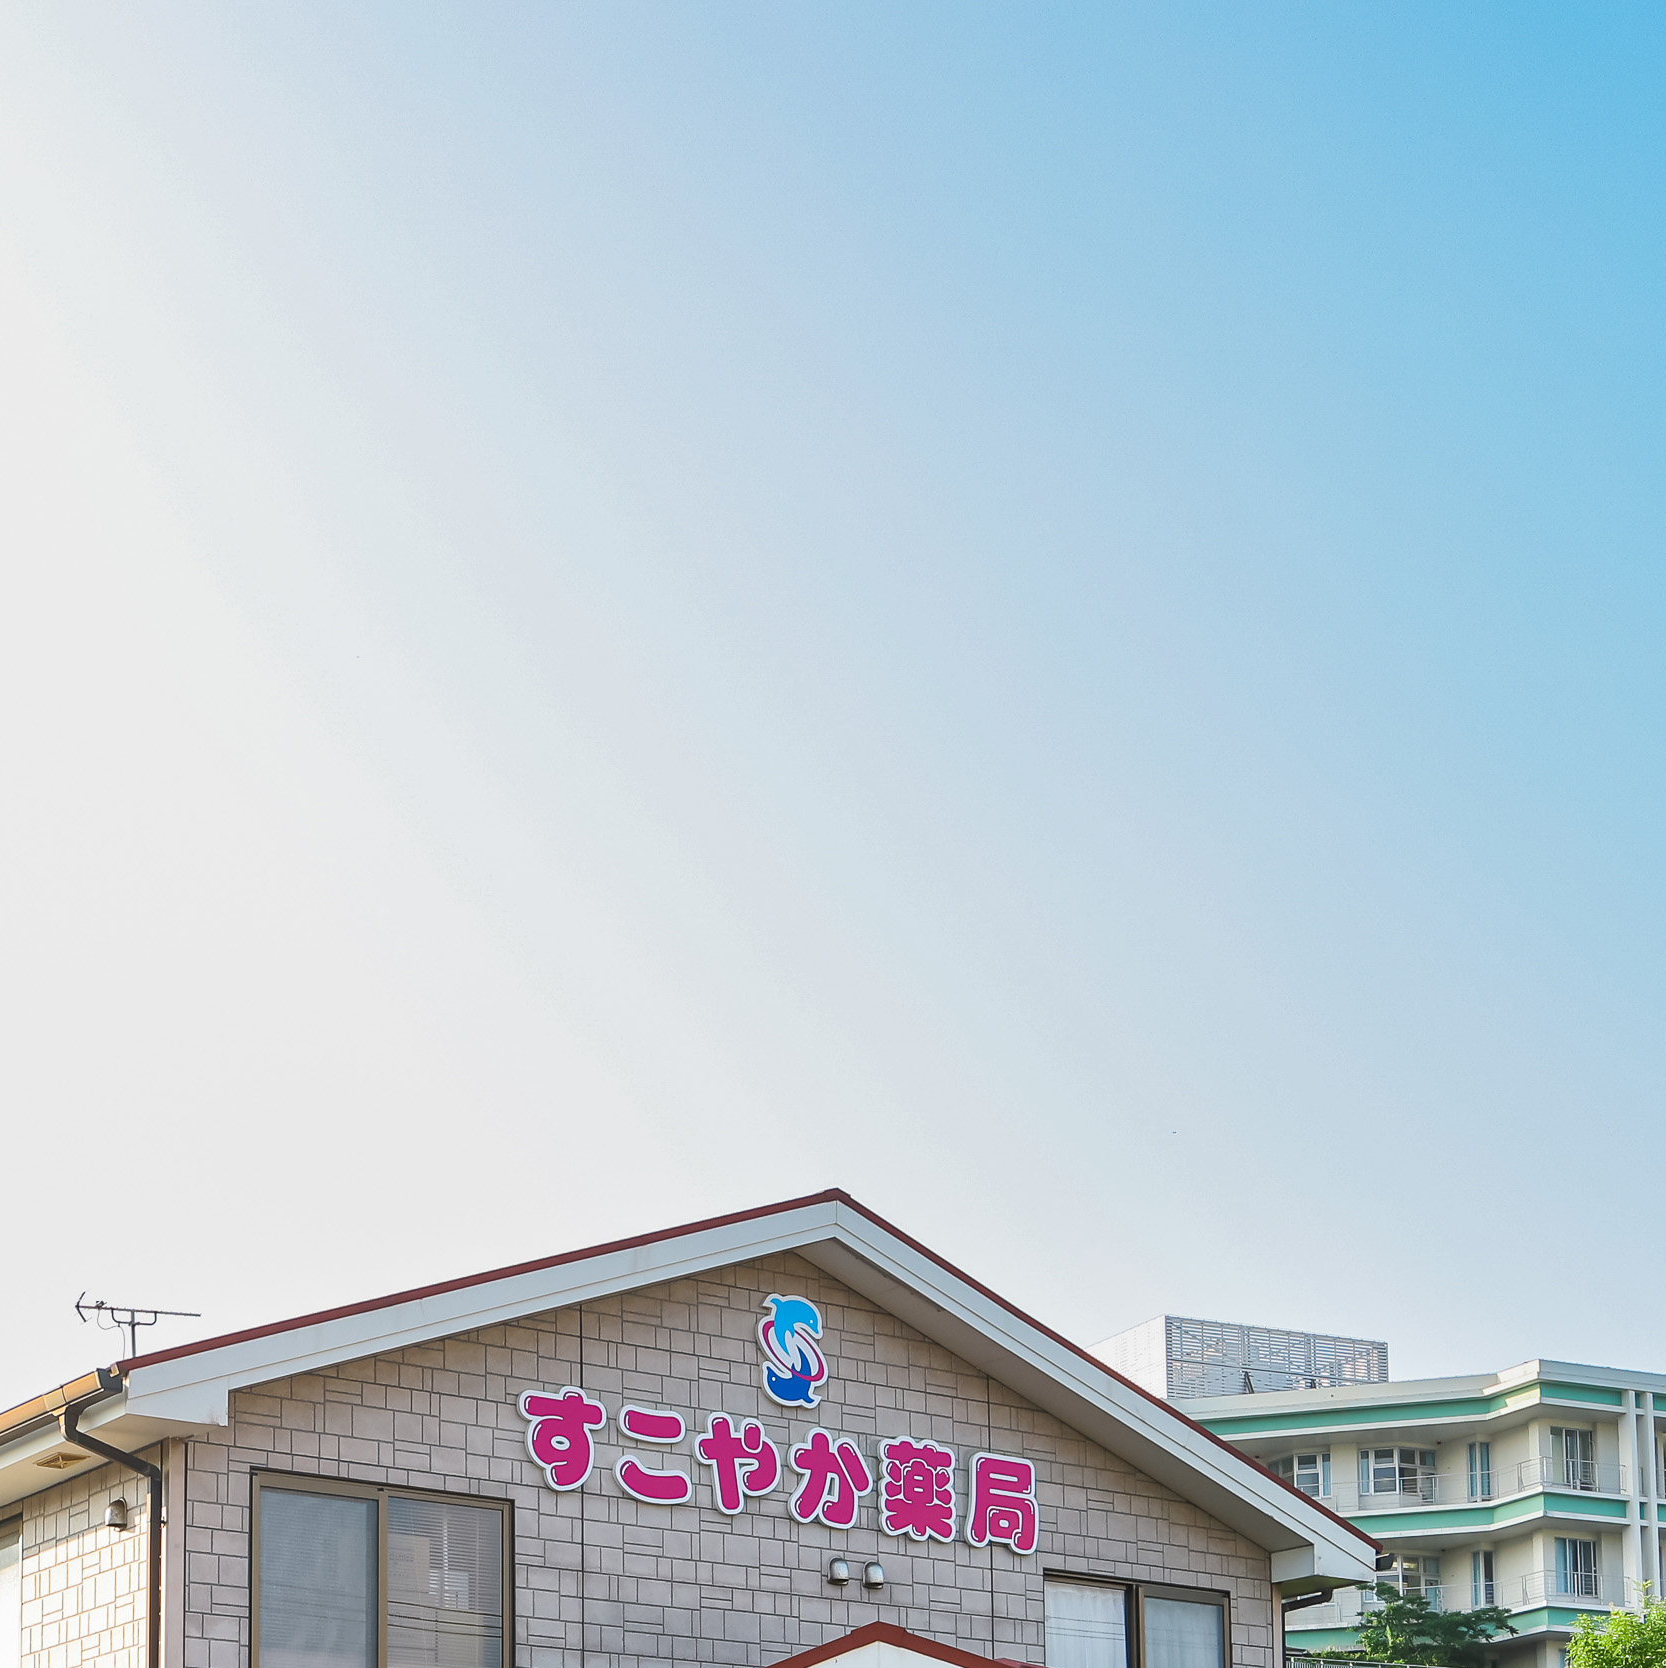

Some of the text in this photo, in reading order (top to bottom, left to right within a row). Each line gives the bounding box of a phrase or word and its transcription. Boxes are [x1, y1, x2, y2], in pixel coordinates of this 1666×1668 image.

[517, 1386, 1039, 1555] すこやか薬局
